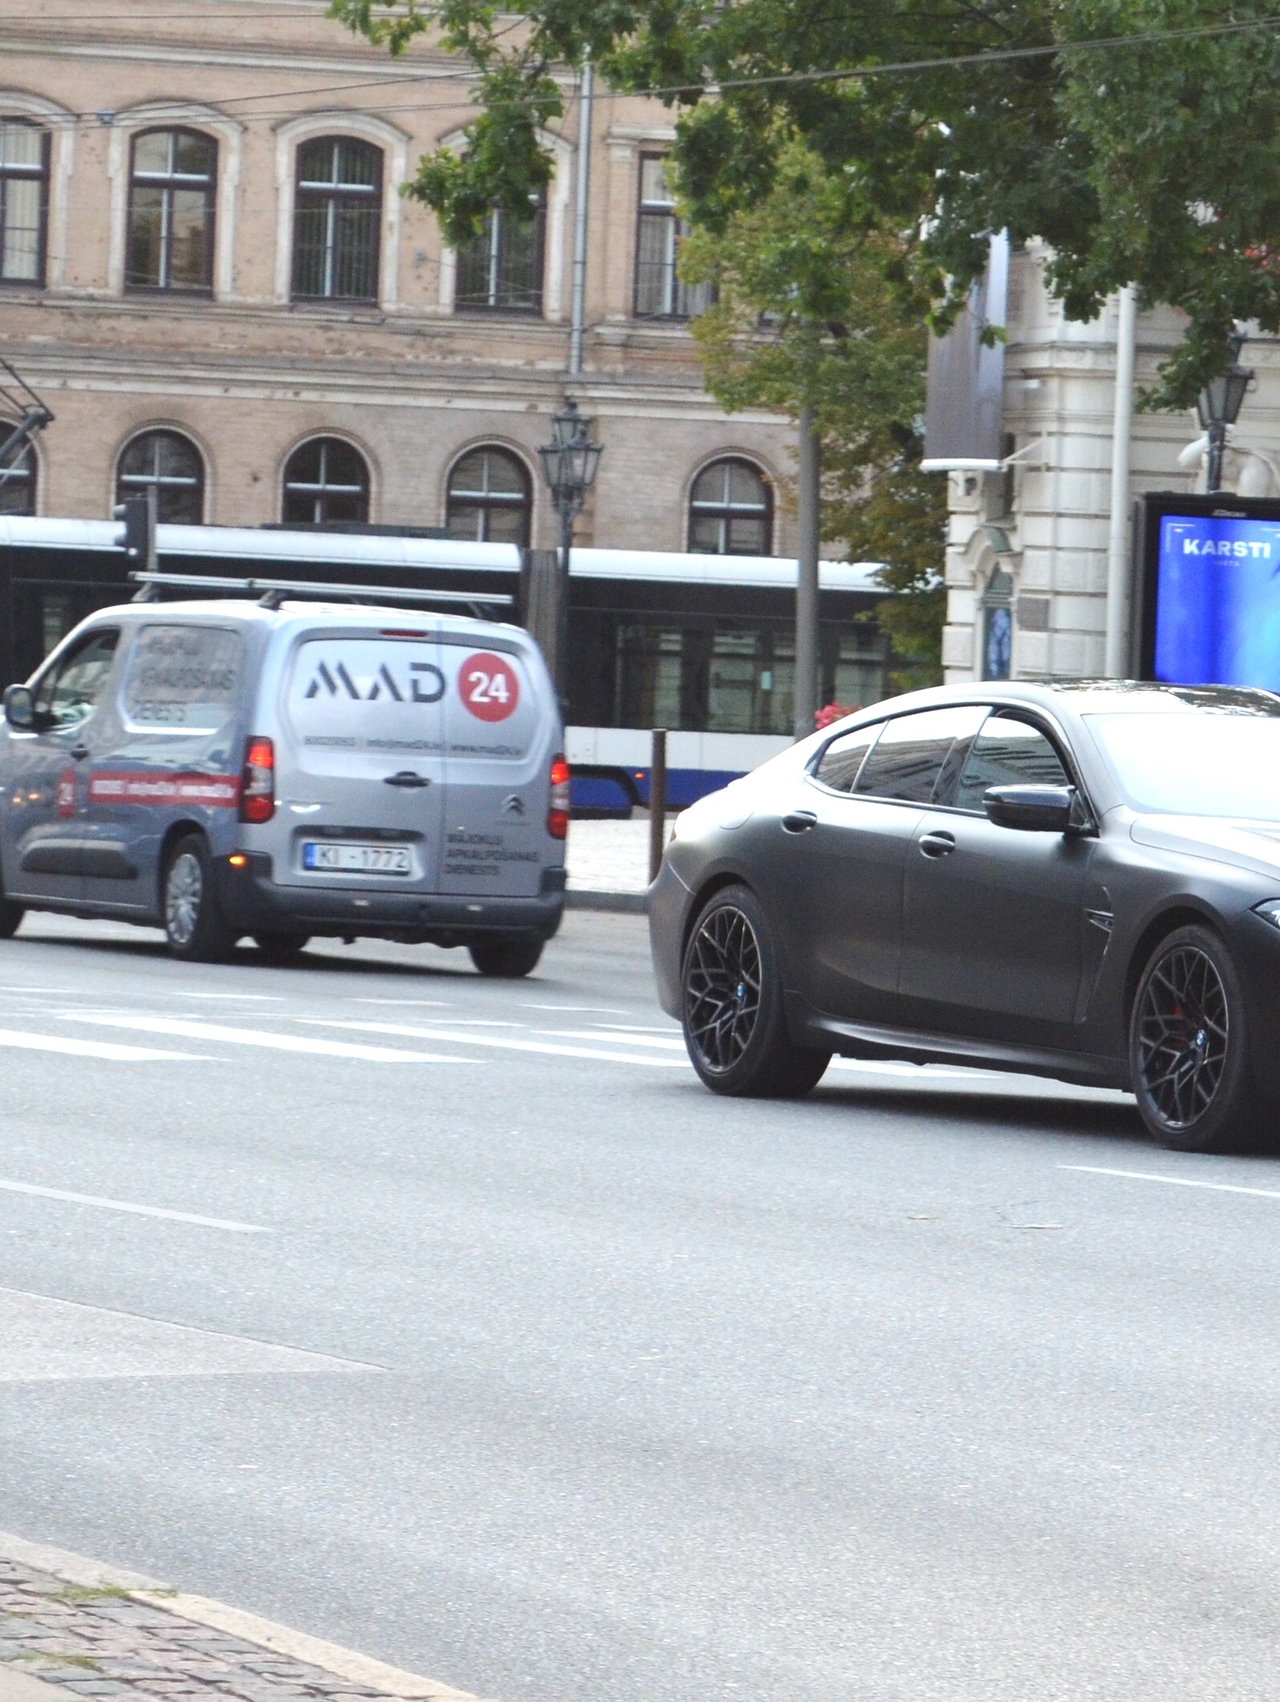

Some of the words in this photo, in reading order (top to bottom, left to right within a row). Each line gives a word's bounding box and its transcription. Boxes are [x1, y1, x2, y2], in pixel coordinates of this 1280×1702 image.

[1183, 538, 1272, 559] KARSTI
[305, 660, 447, 703] MAD
[468, 671, 510, 704] 24
